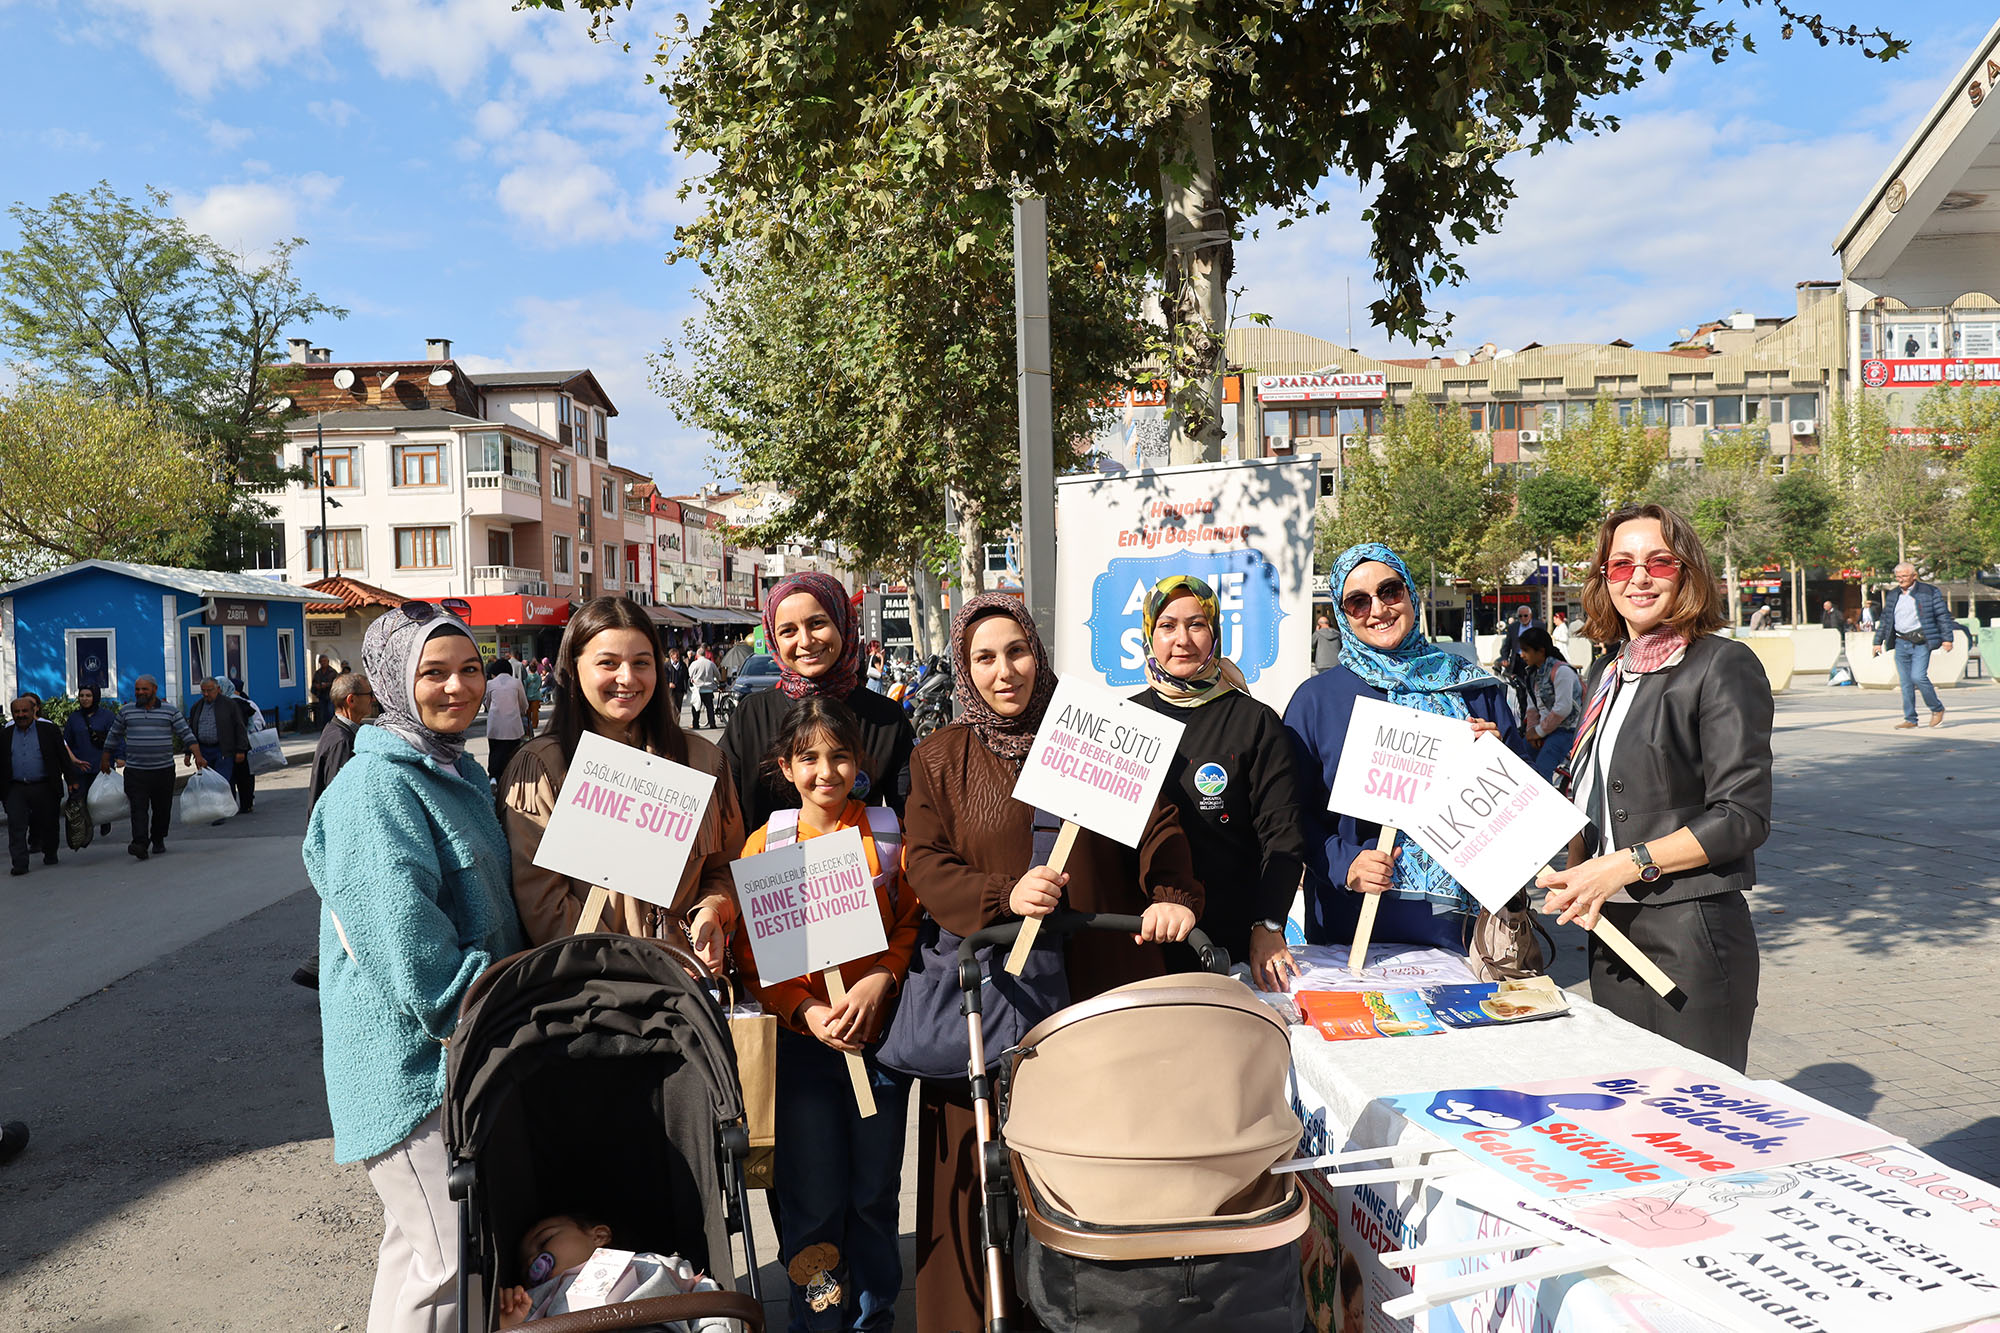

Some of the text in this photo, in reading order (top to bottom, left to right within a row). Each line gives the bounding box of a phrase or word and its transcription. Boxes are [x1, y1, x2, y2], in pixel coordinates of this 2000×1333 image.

[1279, 375, 1384, 388] KARAKADILAR
[1893, 364, 1942, 382] JANEM
[1151, 498, 1213, 520] Hayata
[1118, 524, 1250, 549] En İyi Başlangıç
[534, 605, 553, 615] vodafone
[885, 599, 909, 608] HALK
[1049, 729, 1150, 781] ANNE BEBEK BAĞINI
[1056, 704, 1161, 764] ANNE SÜTÜ
[1375, 725, 1442, 761] MUCİZE
[583, 760, 700, 812] SAĞLIKLI NESİLLER İÇİN
[1041, 746, 1143, 804] GÜÇLENDİRİR
[1371, 750, 1435, 778] SÜTÜNÜZDE
[571, 781, 694, 842] ANNE SÜTÜ
[1418, 805, 1475, 855] İLK
[1454, 783, 1540, 868] SADECE ANNE SÜTÜ
[744, 852, 860, 894] SÜRDÜRÜLEBİLİR GELECEK İÇİN
[751, 864, 865, 918] ANNE SÜTÜNÜ
[754, 890, 870, 939] DESTEKLİYORUZ
[1592, 1078, 1788, 1154] Bir Gelecek,
[1674, 1084, 1810, 1128] Sağlıklı
[1463, 1130, 1594, 1193] Gelecek
[1532, 1123, 1661, 1183] Sütüyle
[1631, 1132, 1735, 1172] Anne
[1354, 1183, 1417, 1249] ANNE SÜTÜ
[1798, 1190, 2000, 1292] Vereceğiniz
[1763, 1233, 1893, 1302] Hediye
[1769, 1206, 1943, 1293] En Güzel
[1682, 1255, 1828, 1333] Sütüdü
[1729, 1251, 1830, 1302] Anne
